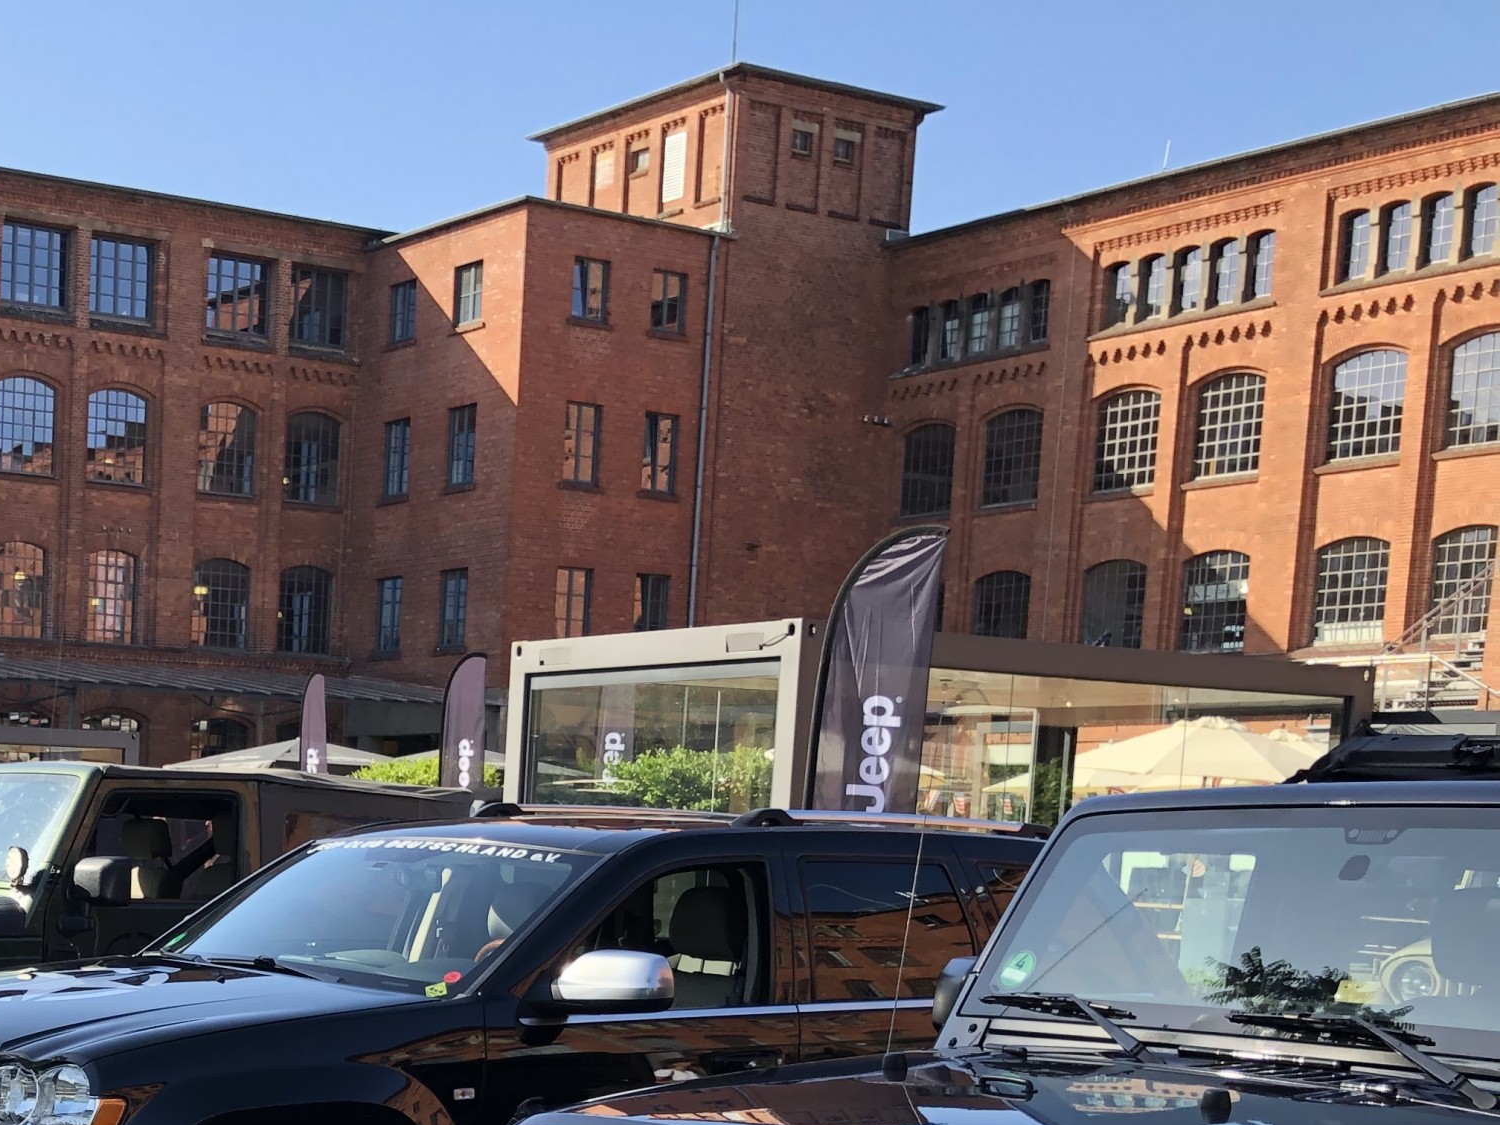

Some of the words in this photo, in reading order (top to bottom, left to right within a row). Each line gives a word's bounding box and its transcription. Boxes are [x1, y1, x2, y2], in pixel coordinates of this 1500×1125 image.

[457, 738, 474, 787] eep
[845, 695, 901, 814] Jeep
[383, 838, 528, 860] DEUTSCHLAND
[1015, 954, 1029, 970] 4
